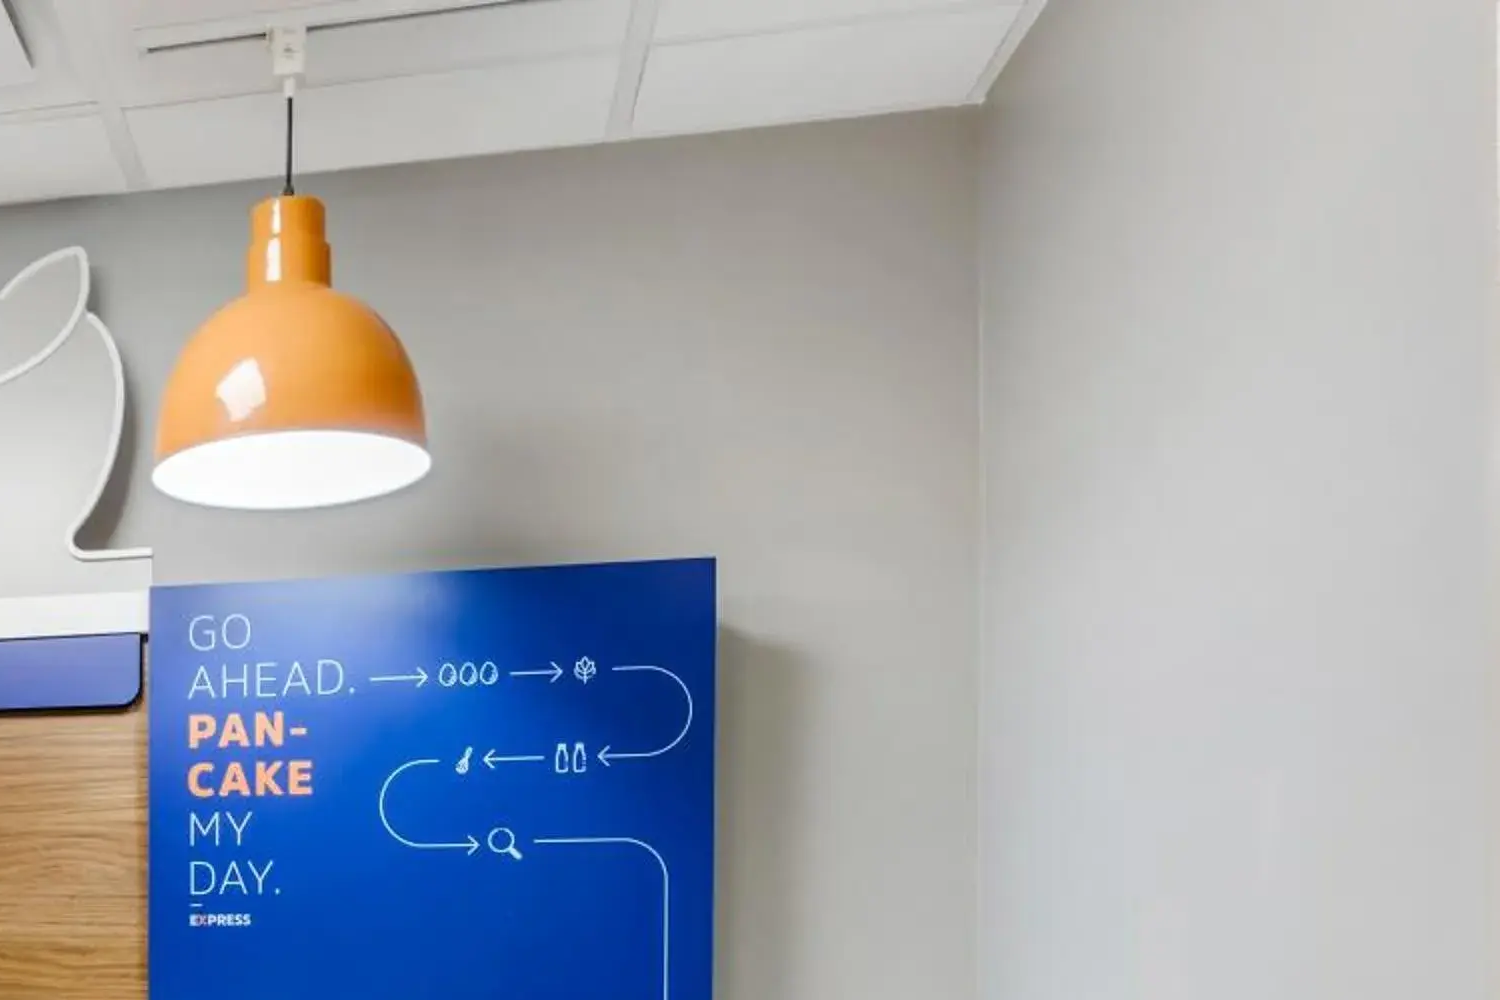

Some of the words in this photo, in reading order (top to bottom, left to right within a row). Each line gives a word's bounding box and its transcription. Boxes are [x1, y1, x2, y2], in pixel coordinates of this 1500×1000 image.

[188, 613, 252, 651] GO
[187, 659, 356, 701] AHEAD.
[188, 712, 308, 749] PAN-
[188, 761, 314, 797] CAKE
[188, 811, 253, 847] MY
[188, 860, 281, 896] DAY.
[189, 913, 252, 927] EXPRESS
